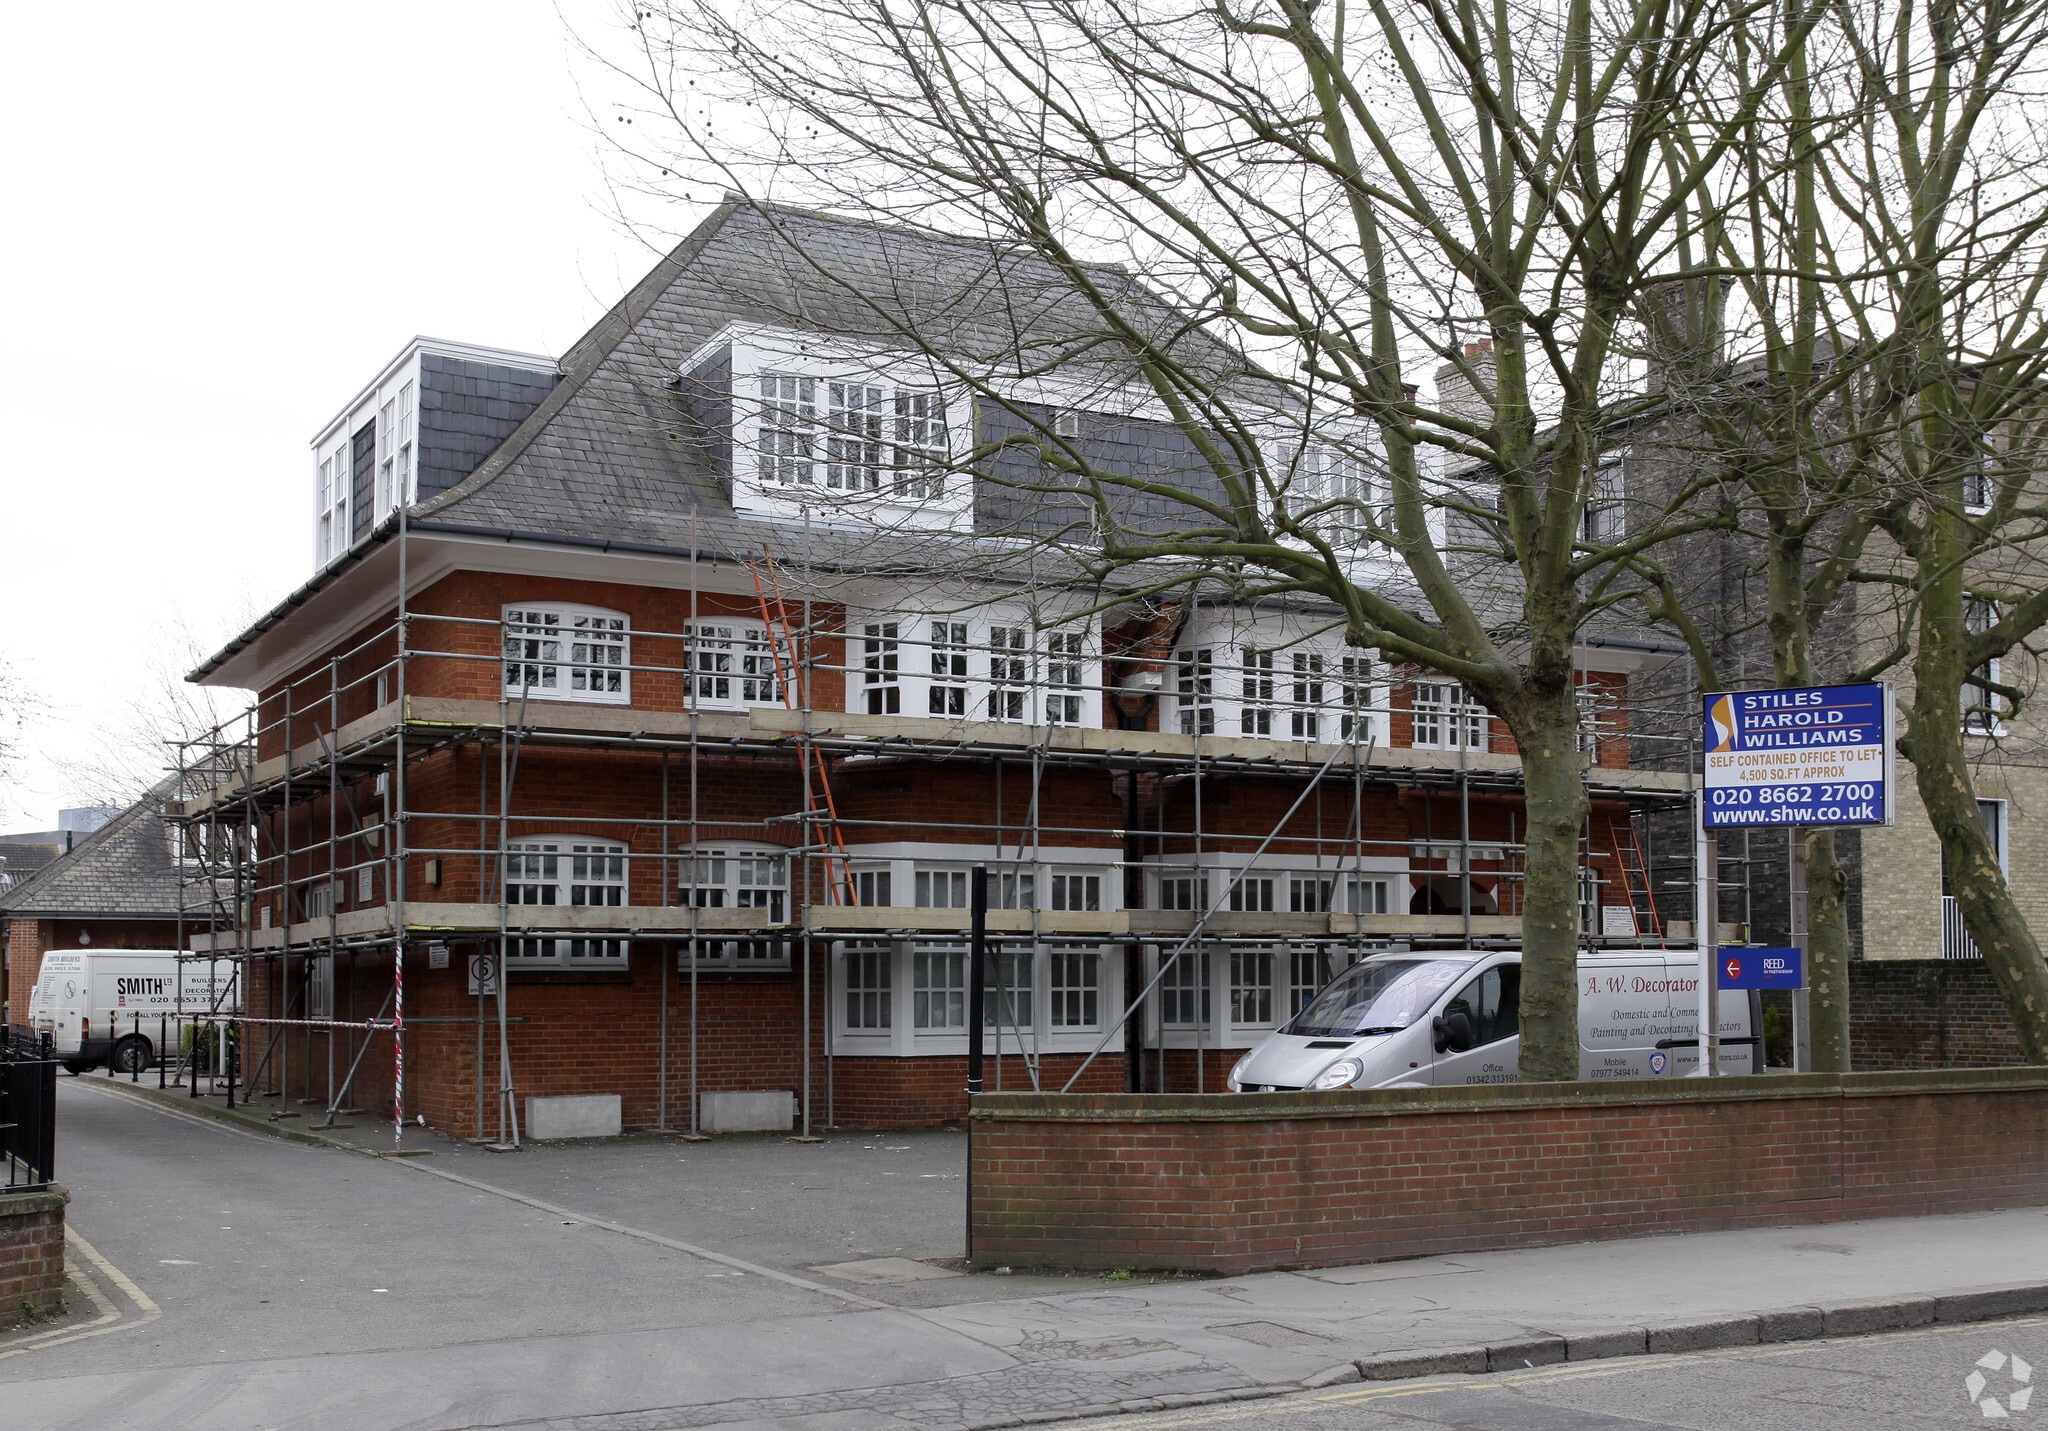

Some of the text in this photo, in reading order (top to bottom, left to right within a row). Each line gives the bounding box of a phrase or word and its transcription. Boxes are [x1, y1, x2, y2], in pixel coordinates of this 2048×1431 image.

[1744, 692, 1823, 709] STILES
[1744, 711, 1844, 729] HAROLD
[1744, 729, 1863, 747] WILLIAMS
[1710, 749, 1877, 768] SELF CONTAINED OFFICE TO LET
[1739, 766, 1845, 783] 4,500 SQ.FT APPROX
[1712, 783, 1875, 805] 020 8662 2700
[1712, 802, 1874, 823] www.shw.co.uk
[1763, 958, 1785, 969] REED
[117, 977, 163, 995] SMITH
[1584, 975, 1699, 996] A. W. Decorator
[1611, 1006, 1699, 1020] Domestic and Comme
[1590, 1026, 1628, 1040] Painting
[1630, 1023, 1648, 1036] and
[1648, 1023, 1694, 1037] Decorating
[1482, 1063, 1504, 1072] Office
[1604, 1058, 1627, 1067] Mobile
[1466, 1074, 1518, 1084] 01342 313191
[1591, 1068, 1639, 1078] 07977 549414
